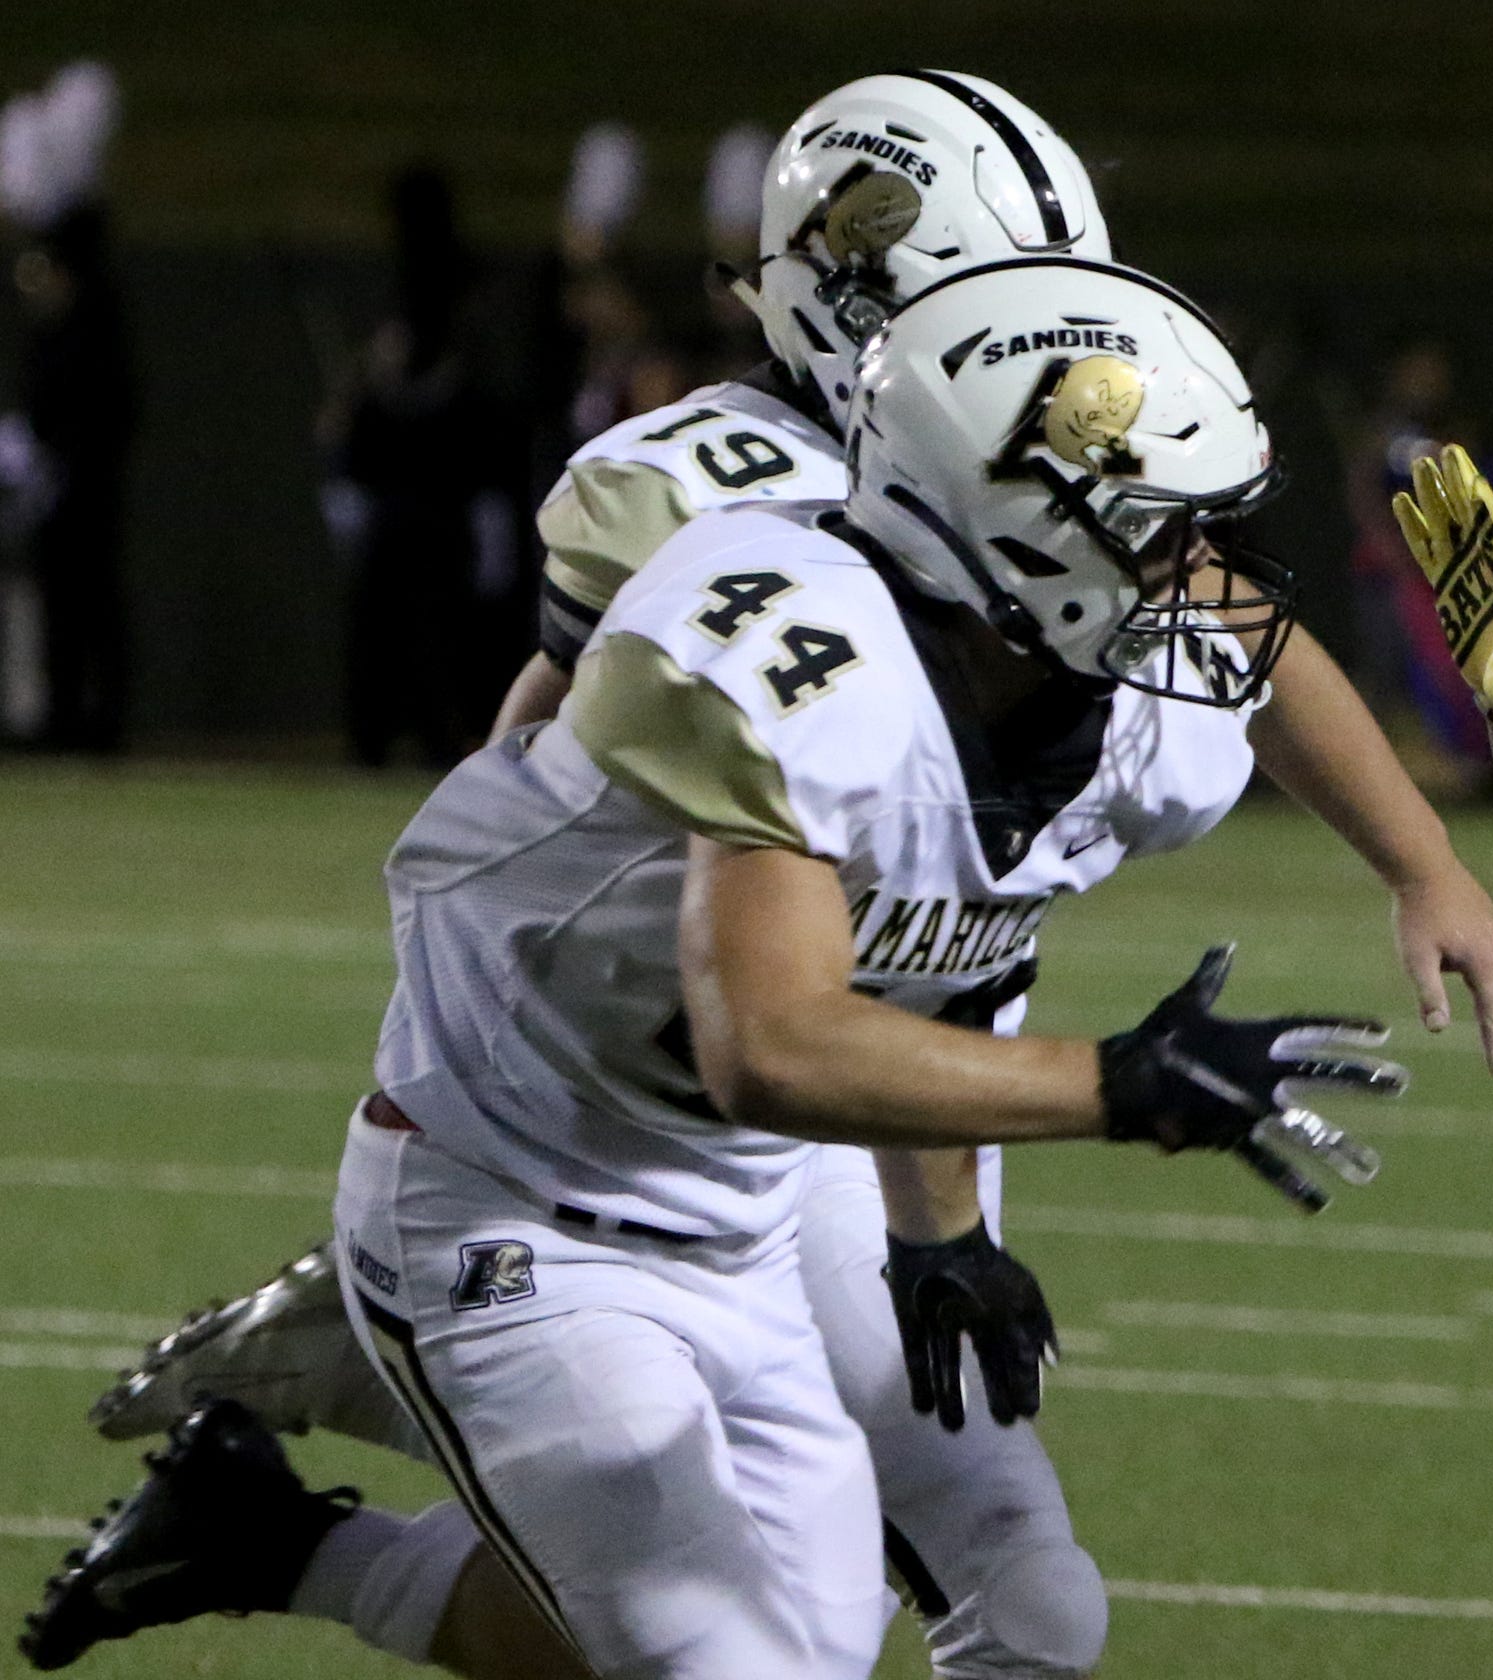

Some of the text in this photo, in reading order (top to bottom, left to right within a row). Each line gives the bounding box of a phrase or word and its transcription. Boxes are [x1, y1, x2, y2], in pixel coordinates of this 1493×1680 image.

[820, 130, 939, 187] SANDIES
[981, 328, 1138, 366] SANDIES
[643, 406, 802, 493] 19
[682, 566, 864, 721] 44
